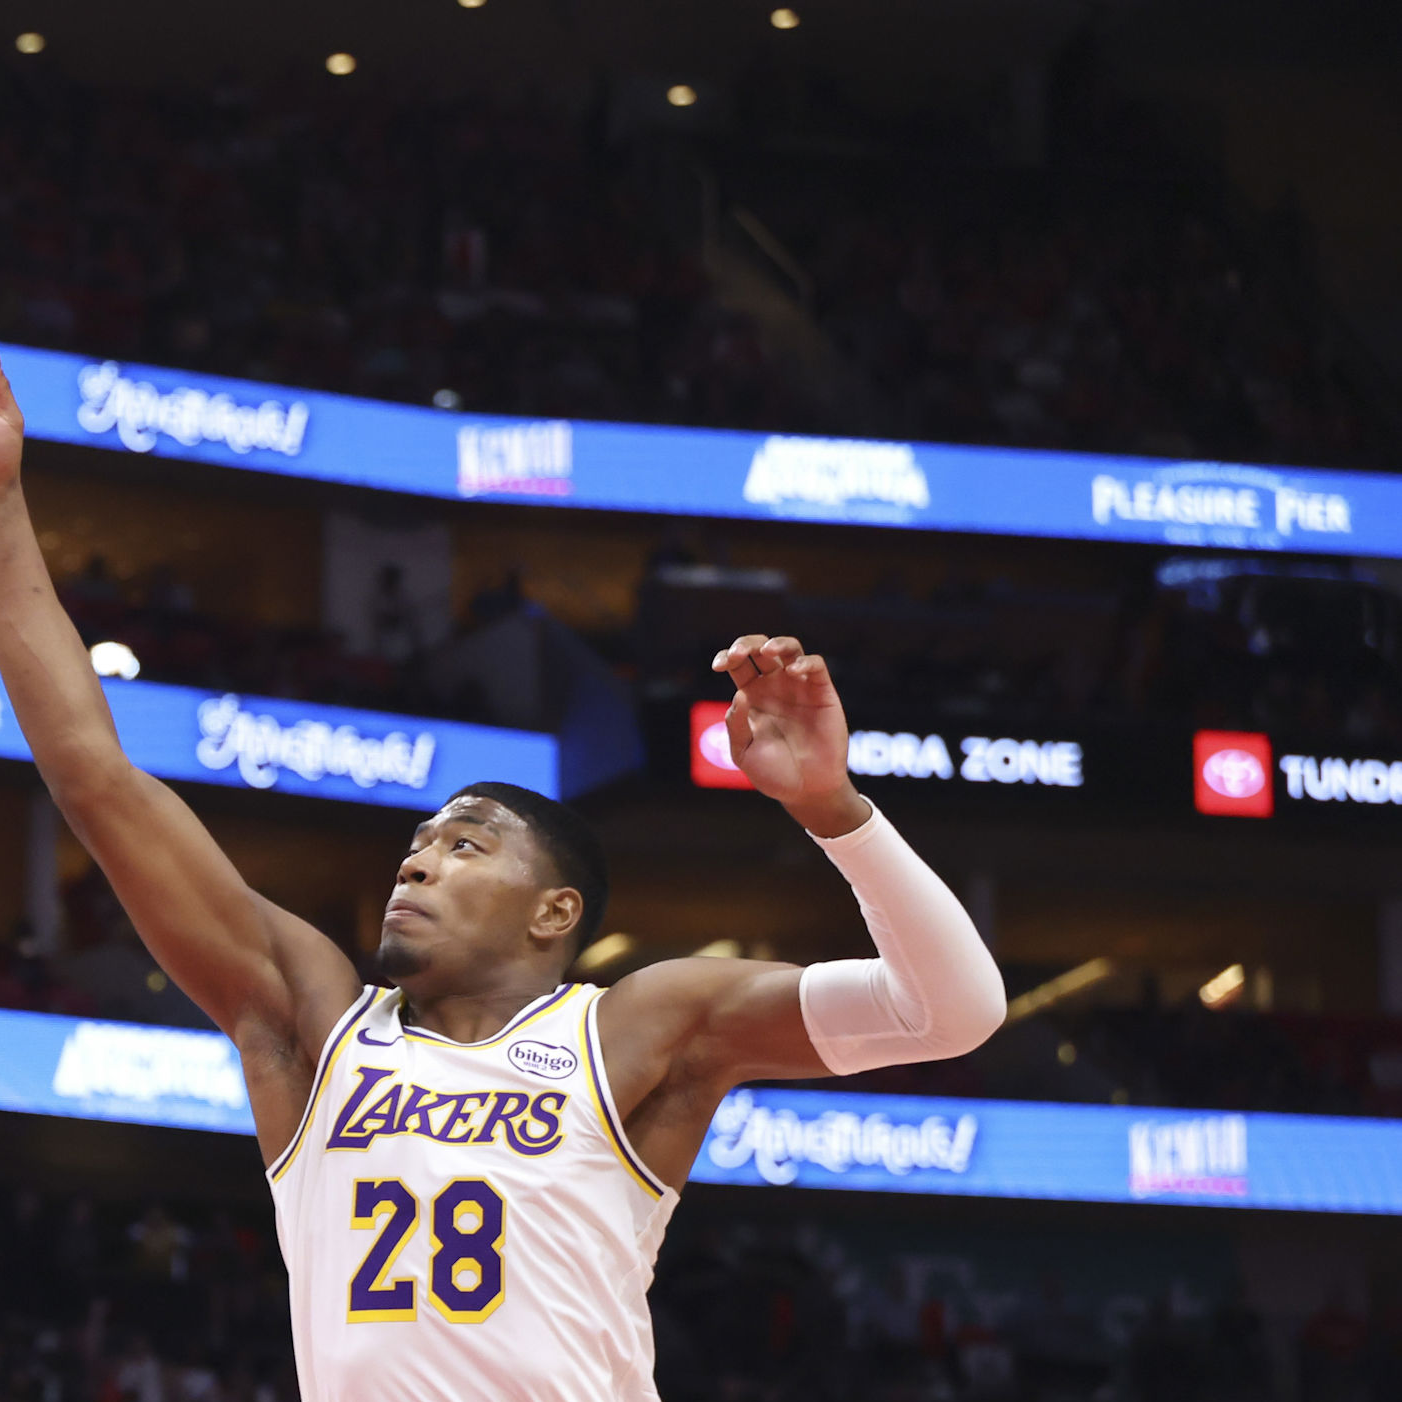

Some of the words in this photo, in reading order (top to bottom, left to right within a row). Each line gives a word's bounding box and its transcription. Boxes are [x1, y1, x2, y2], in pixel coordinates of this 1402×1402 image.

[959, 736, 1084, 787] ZONE
[514, 1047, 574, 1071] bibigo
[325, 1066, 572, 1159] LAKERS
[346, 1177, 507, 1325] 28
